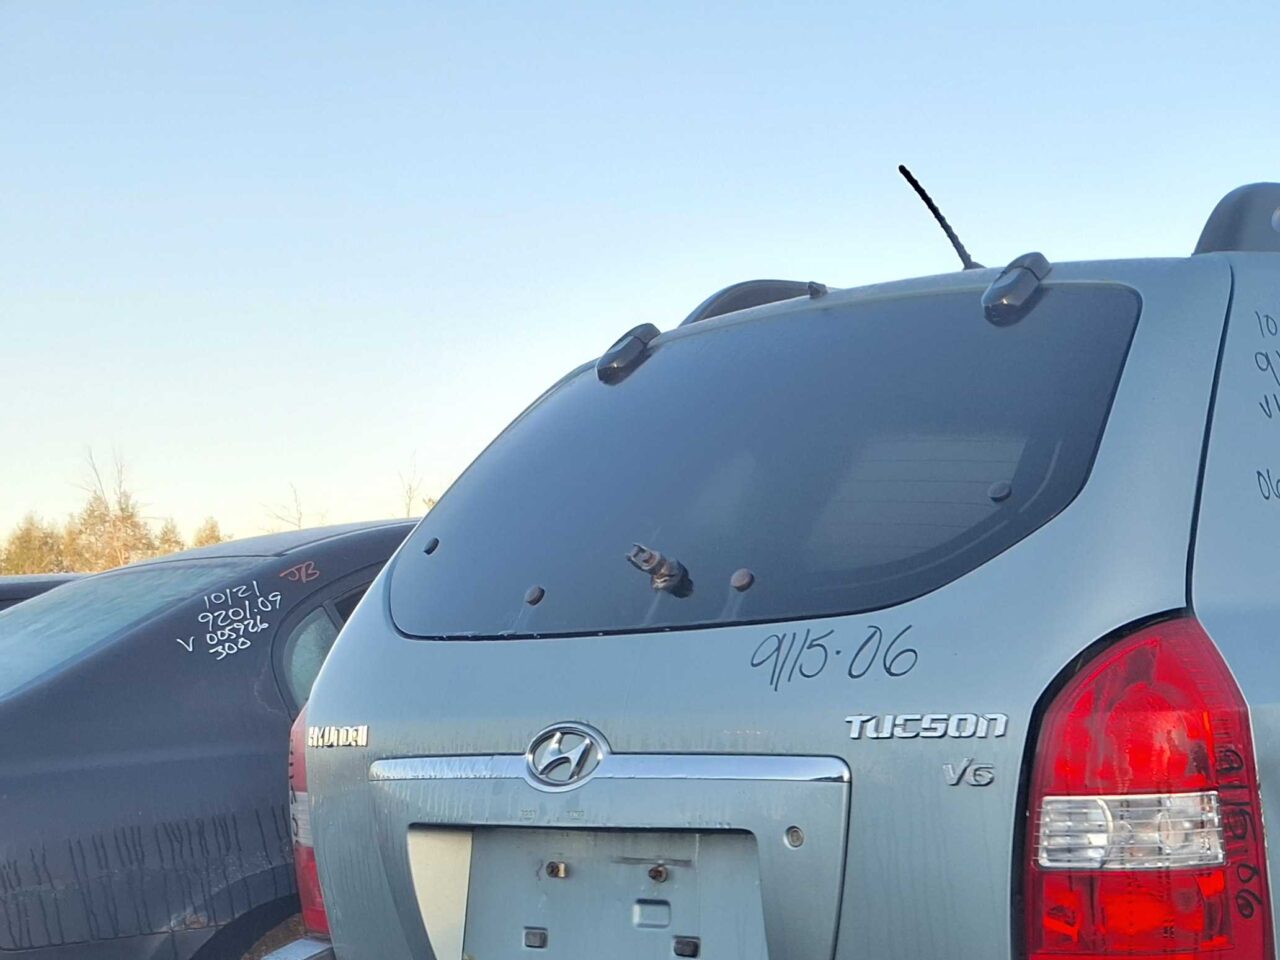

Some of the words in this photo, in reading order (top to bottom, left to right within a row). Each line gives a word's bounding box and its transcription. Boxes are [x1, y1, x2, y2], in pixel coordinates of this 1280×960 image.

[307, 725, 368, 748] HYUNDAI
[845, 713, 1009, 740] TUCSON
[943, 757, 995, 787] V6
